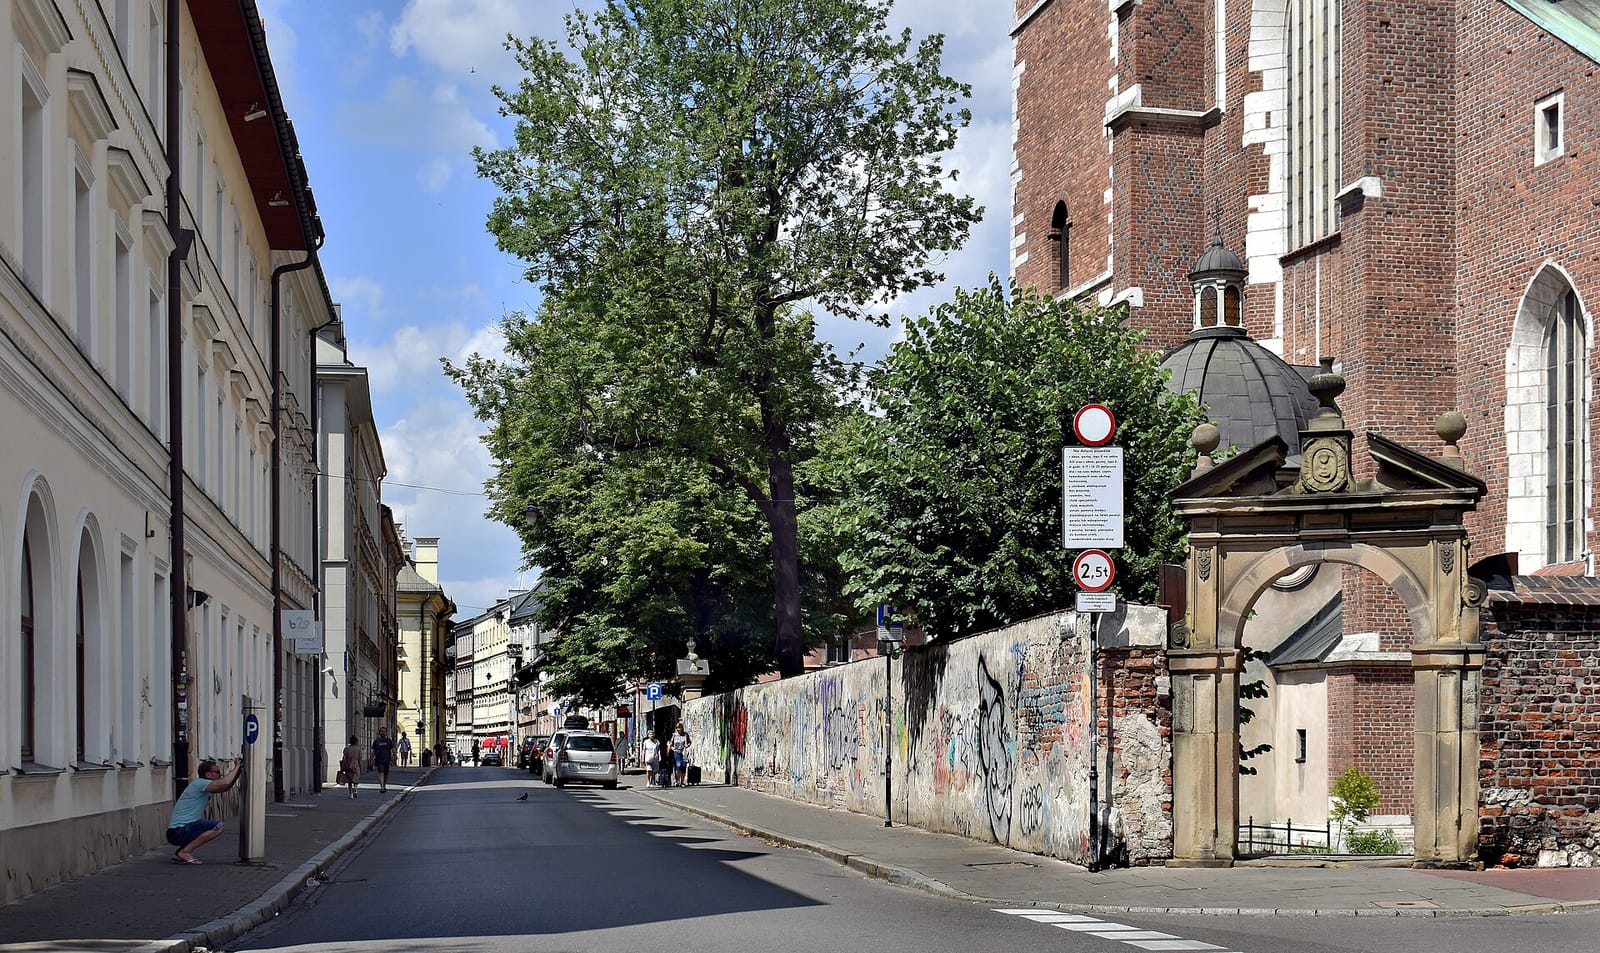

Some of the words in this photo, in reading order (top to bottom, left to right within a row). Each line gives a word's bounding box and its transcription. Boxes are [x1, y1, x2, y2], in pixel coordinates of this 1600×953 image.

[1080, 563, 1108, 580] 2,5t
[650, 687, 659, 698] P
[246, 722, 258, 736] P
